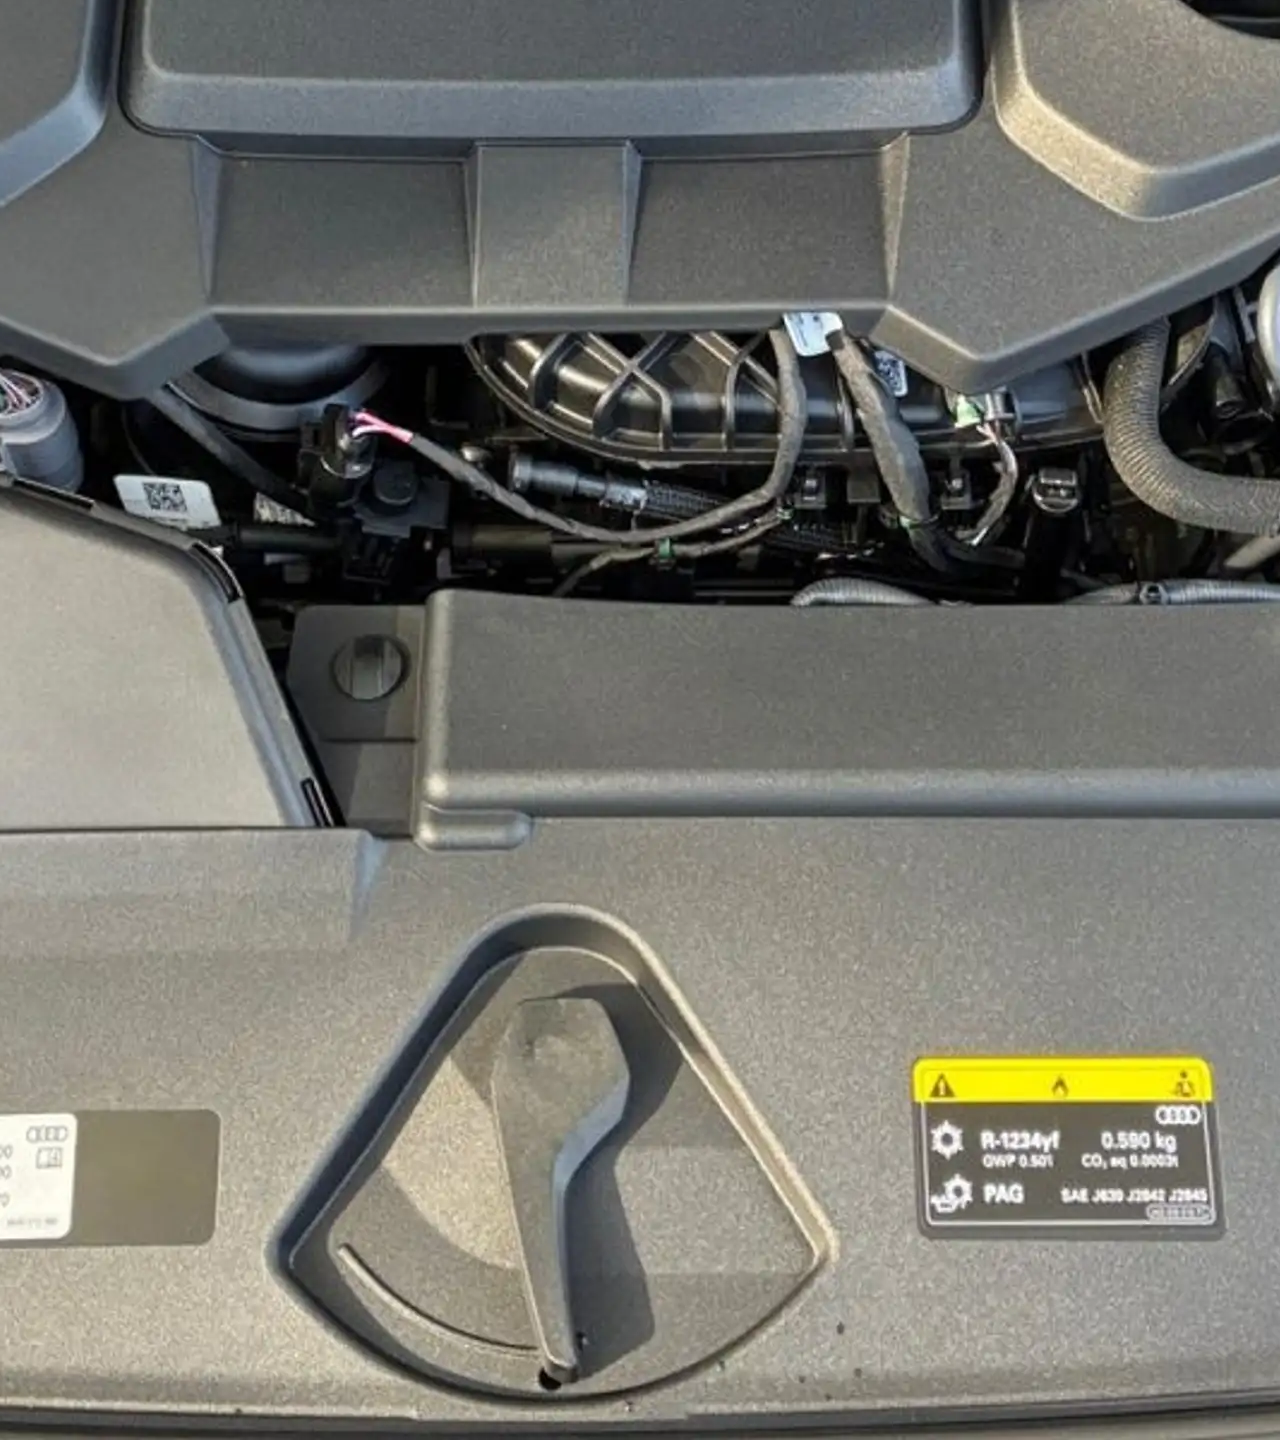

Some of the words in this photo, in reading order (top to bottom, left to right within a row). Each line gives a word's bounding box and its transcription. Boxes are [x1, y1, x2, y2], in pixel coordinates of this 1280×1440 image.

[980, 1130, 1061, 1153] R-1234yf
[1154, 1130, 1177, 1153] kg
[983, 1182, 1025, 1205] PAG
